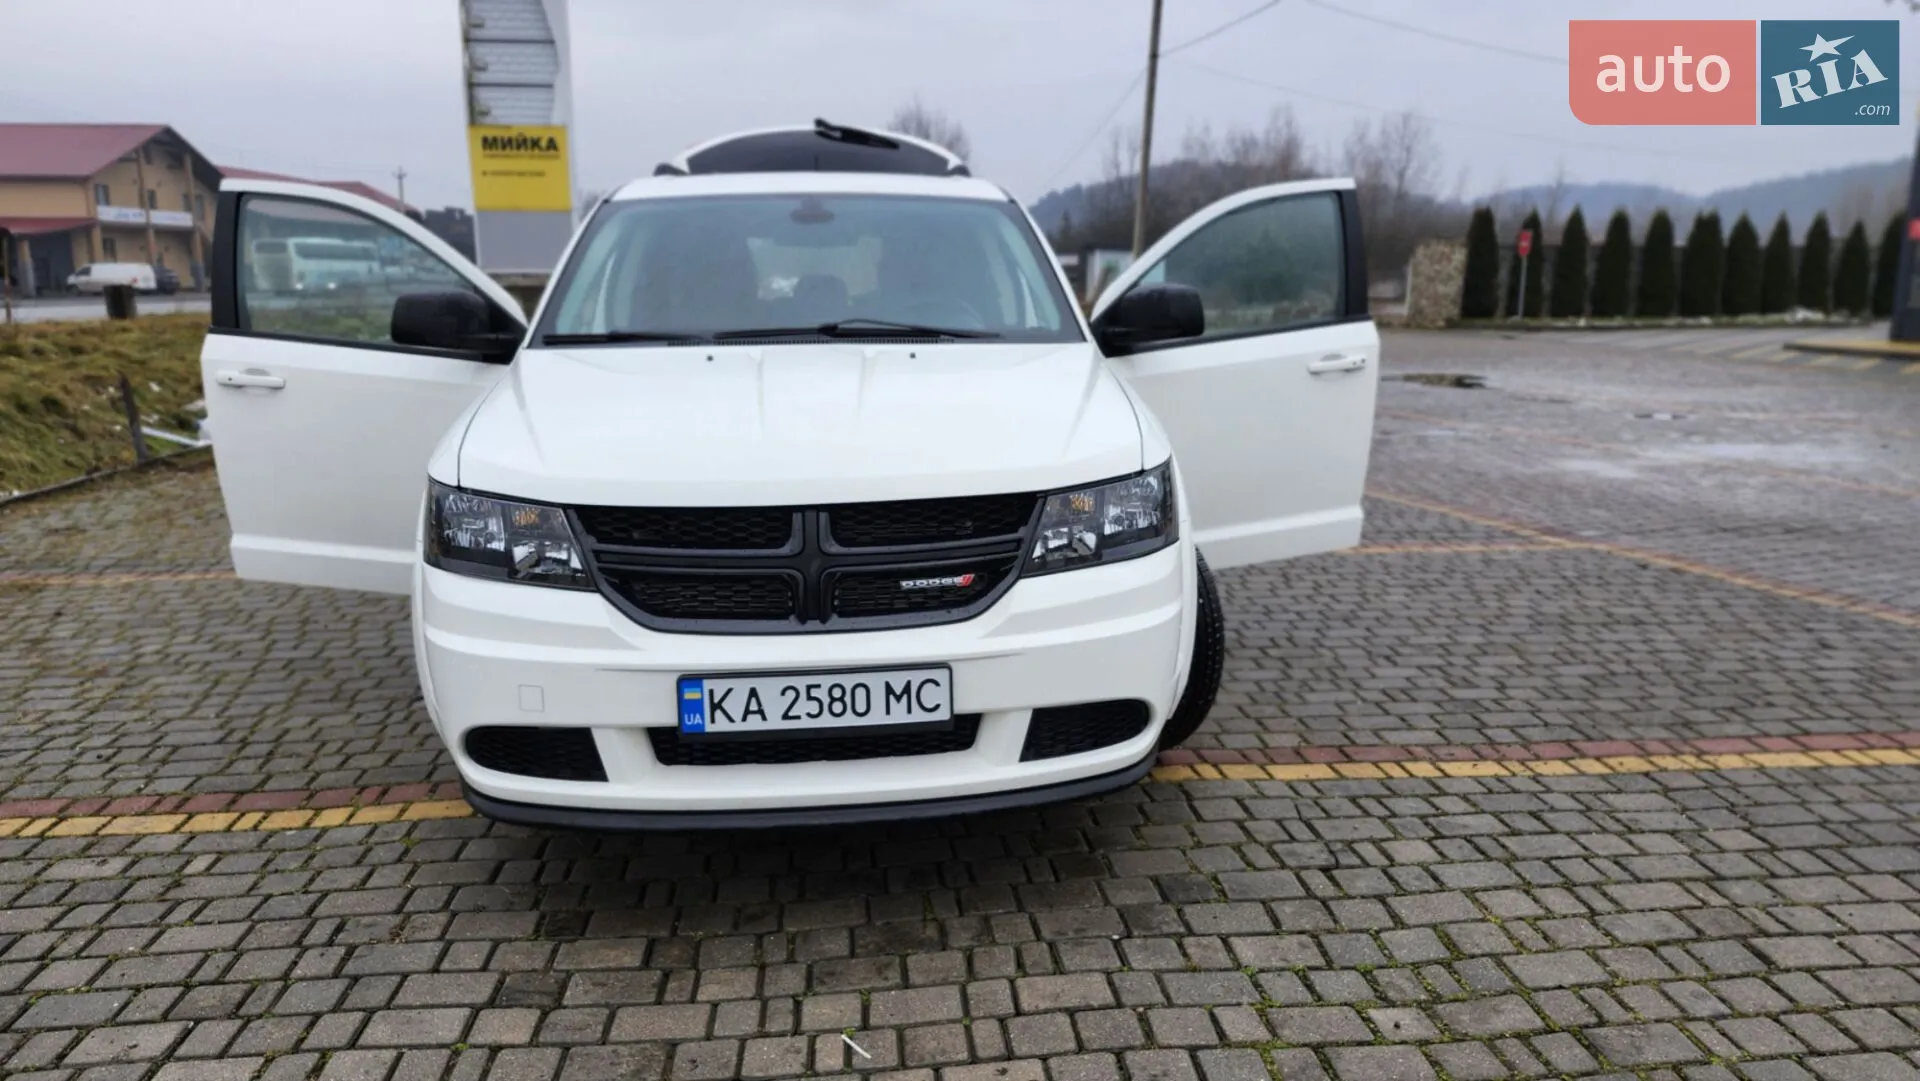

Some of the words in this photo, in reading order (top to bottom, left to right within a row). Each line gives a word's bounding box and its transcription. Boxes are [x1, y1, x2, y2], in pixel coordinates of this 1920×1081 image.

[481, 132, 560, 152] МИЙКА
[900, 576, 963, 589] DODGE
[708, 686, 768, 725] KA
[780, 682, 872, 721] 2580
[884, 678, 942, 716] MC
[684, 713, 703, 726] UA
